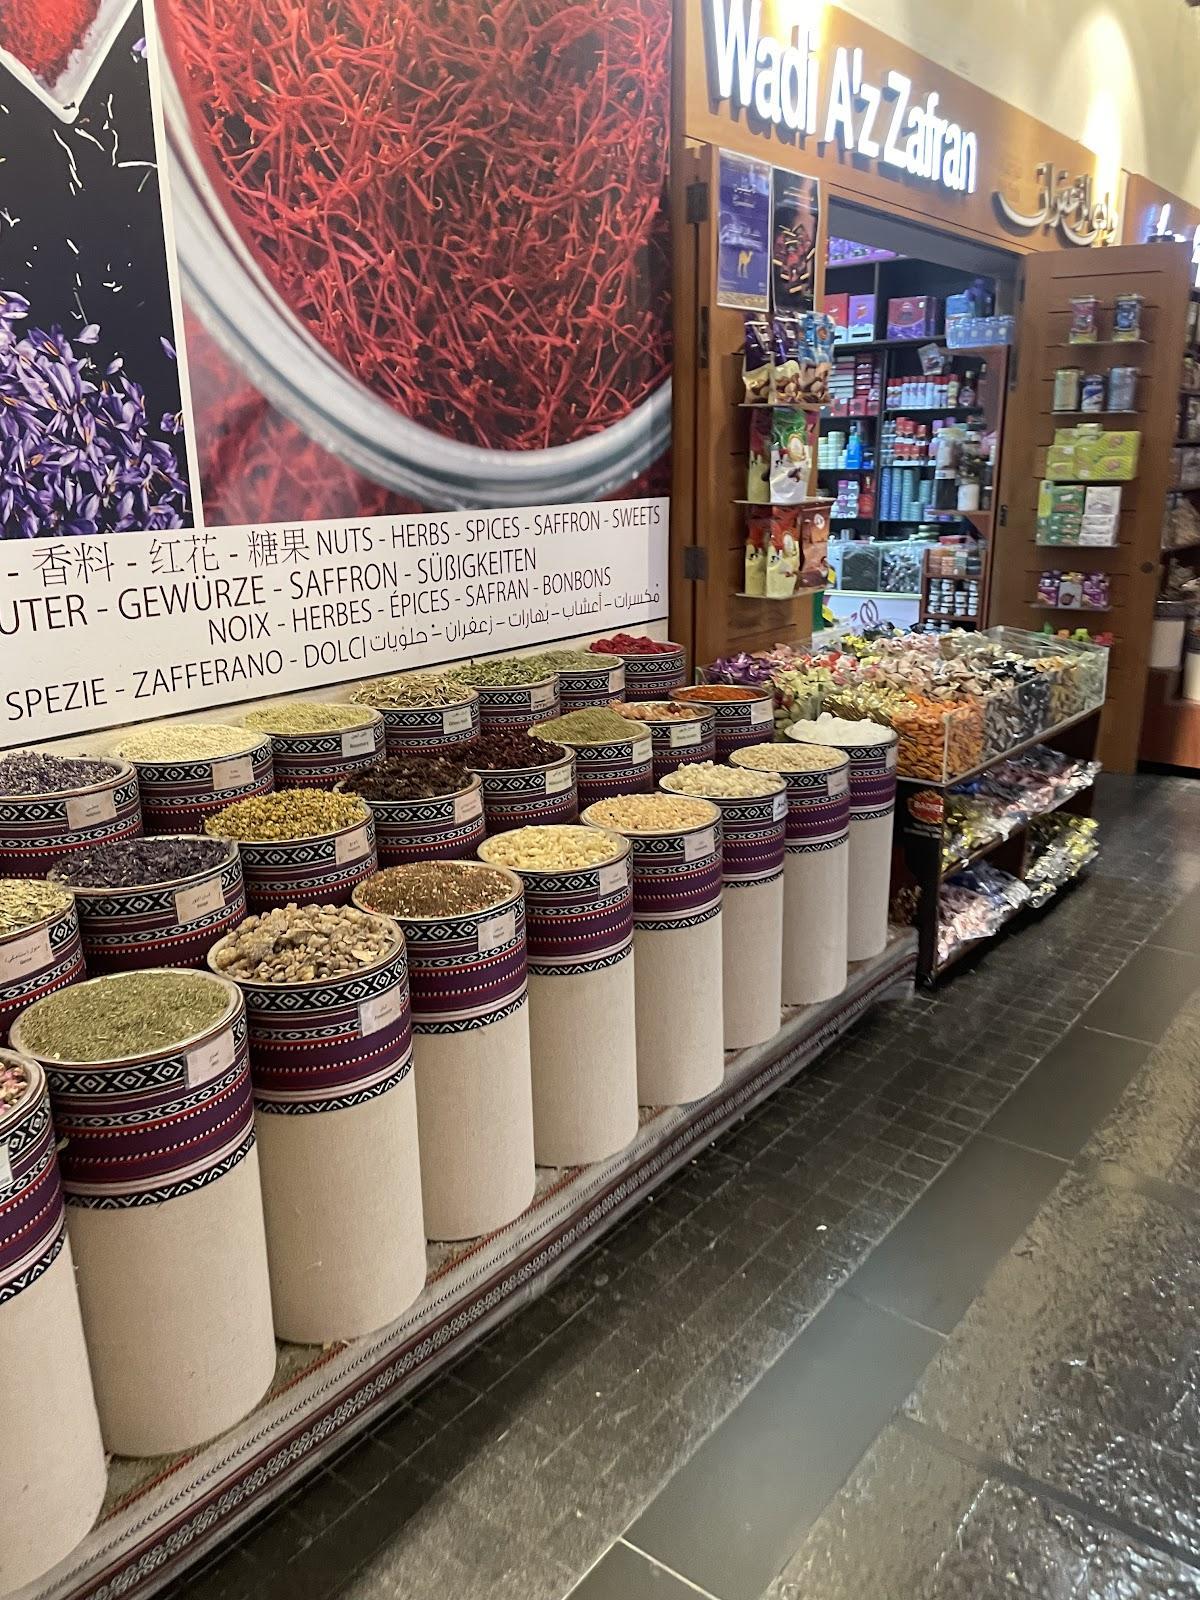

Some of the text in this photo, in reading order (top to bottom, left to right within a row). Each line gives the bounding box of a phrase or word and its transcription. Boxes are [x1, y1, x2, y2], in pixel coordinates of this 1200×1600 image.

[713, 0, 820, 135] Wadi
[883, 70, 978, 194] Zafran
[32, 528, 309, 587] 香料 红花 糖果
[317, 505, 660, 555] NUTS HERBS SPICES SAFFRON SWEETS
[119, 575, 266, 619] GEWÜRZE
[290, 561, 397, 599] SAFFRON
[209, 567, 610, 645] NOIX HERBES ÉPICES SAFRAN BONBONS
[370, 588, 660, 652] مكسرات أعشاب بهارات زعفران حلويات
[6, 636, 366, 720] SPEZIE ZAFFERANO DOLCI
